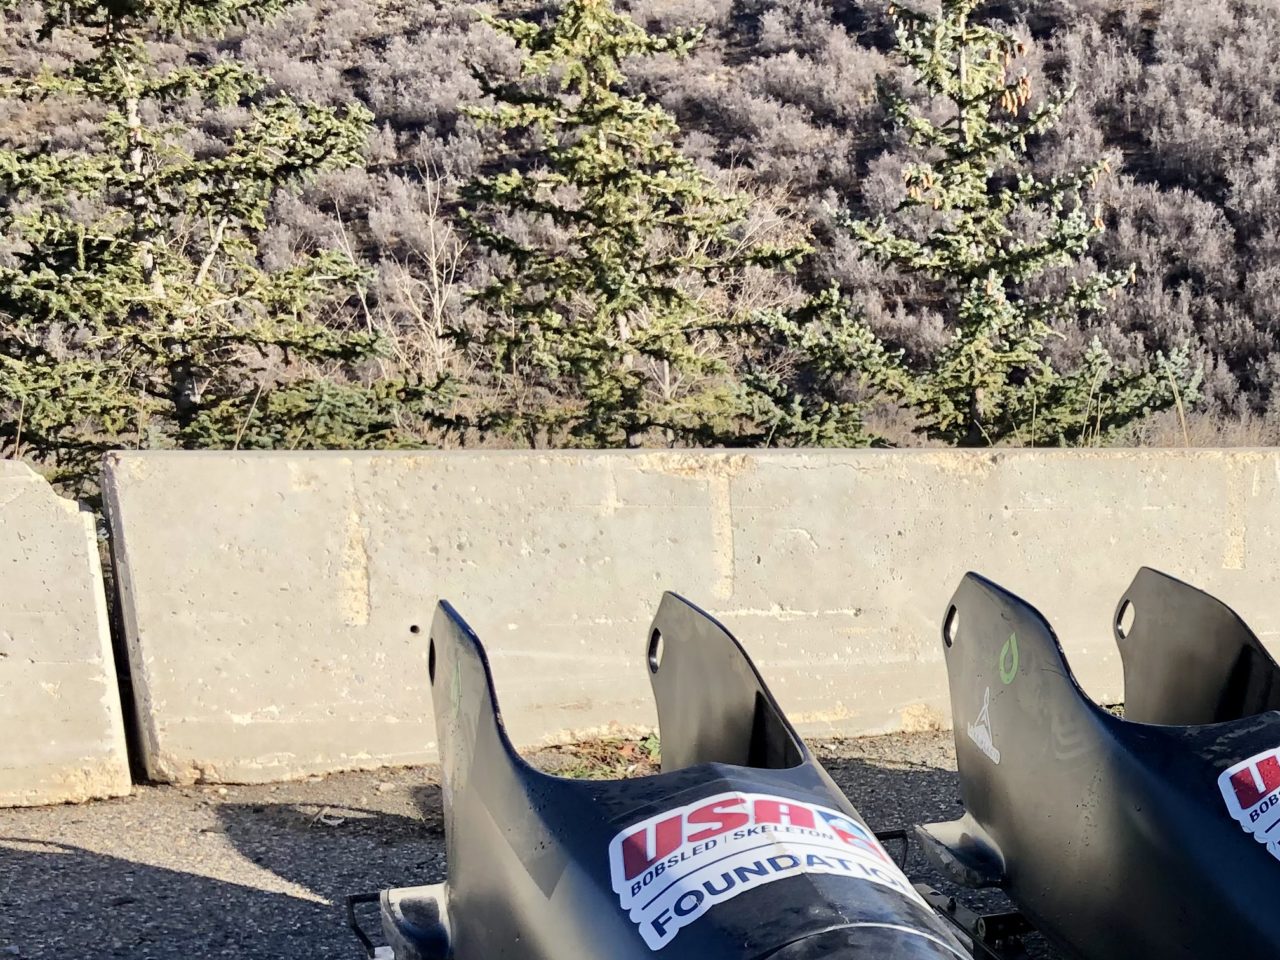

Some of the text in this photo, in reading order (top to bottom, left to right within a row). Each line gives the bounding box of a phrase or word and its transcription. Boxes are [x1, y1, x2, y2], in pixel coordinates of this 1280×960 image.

[622, 798, 817, 881] USA
[630, 825, 835, 898] BOBSLED SKELETON
